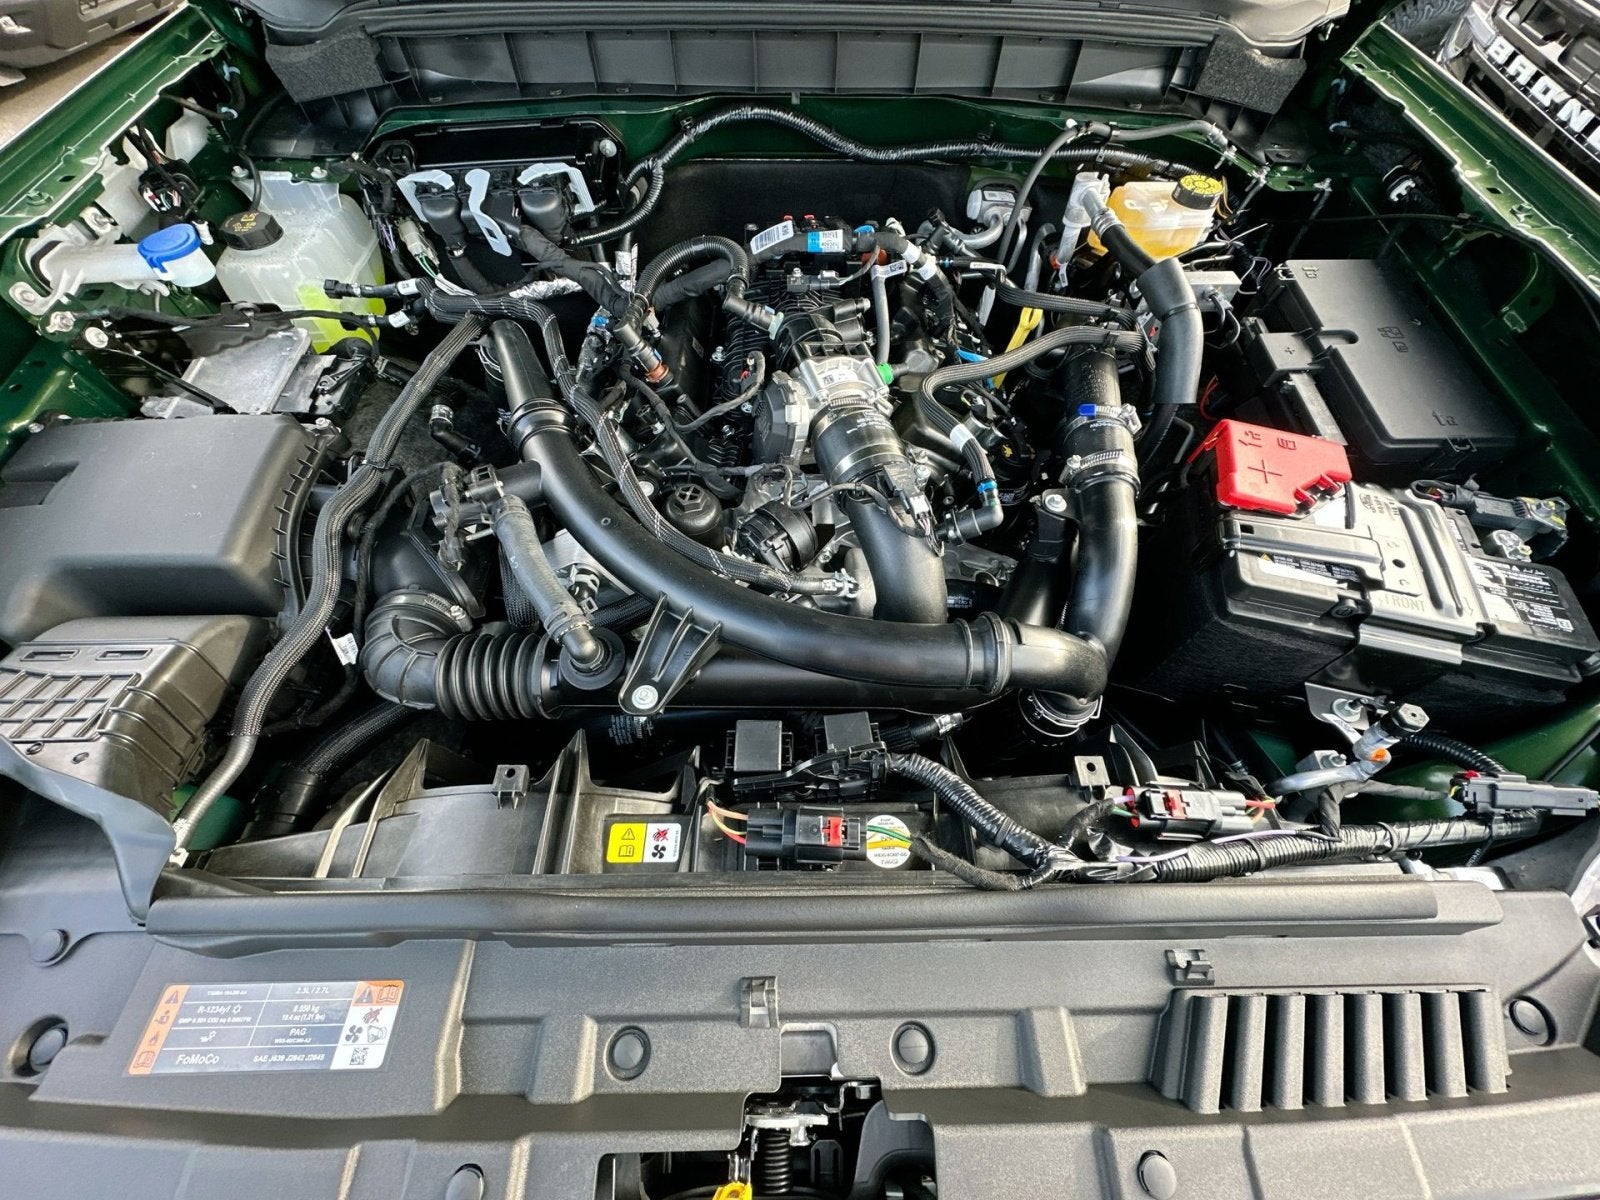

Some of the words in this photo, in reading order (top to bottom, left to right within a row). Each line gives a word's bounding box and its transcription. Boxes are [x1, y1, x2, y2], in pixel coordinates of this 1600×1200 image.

[1385, 593, 1425, 612] FRONT
[289, 1027, 307, 1036] PAG
[175, 1053, 220, 1065] FoMoCo
